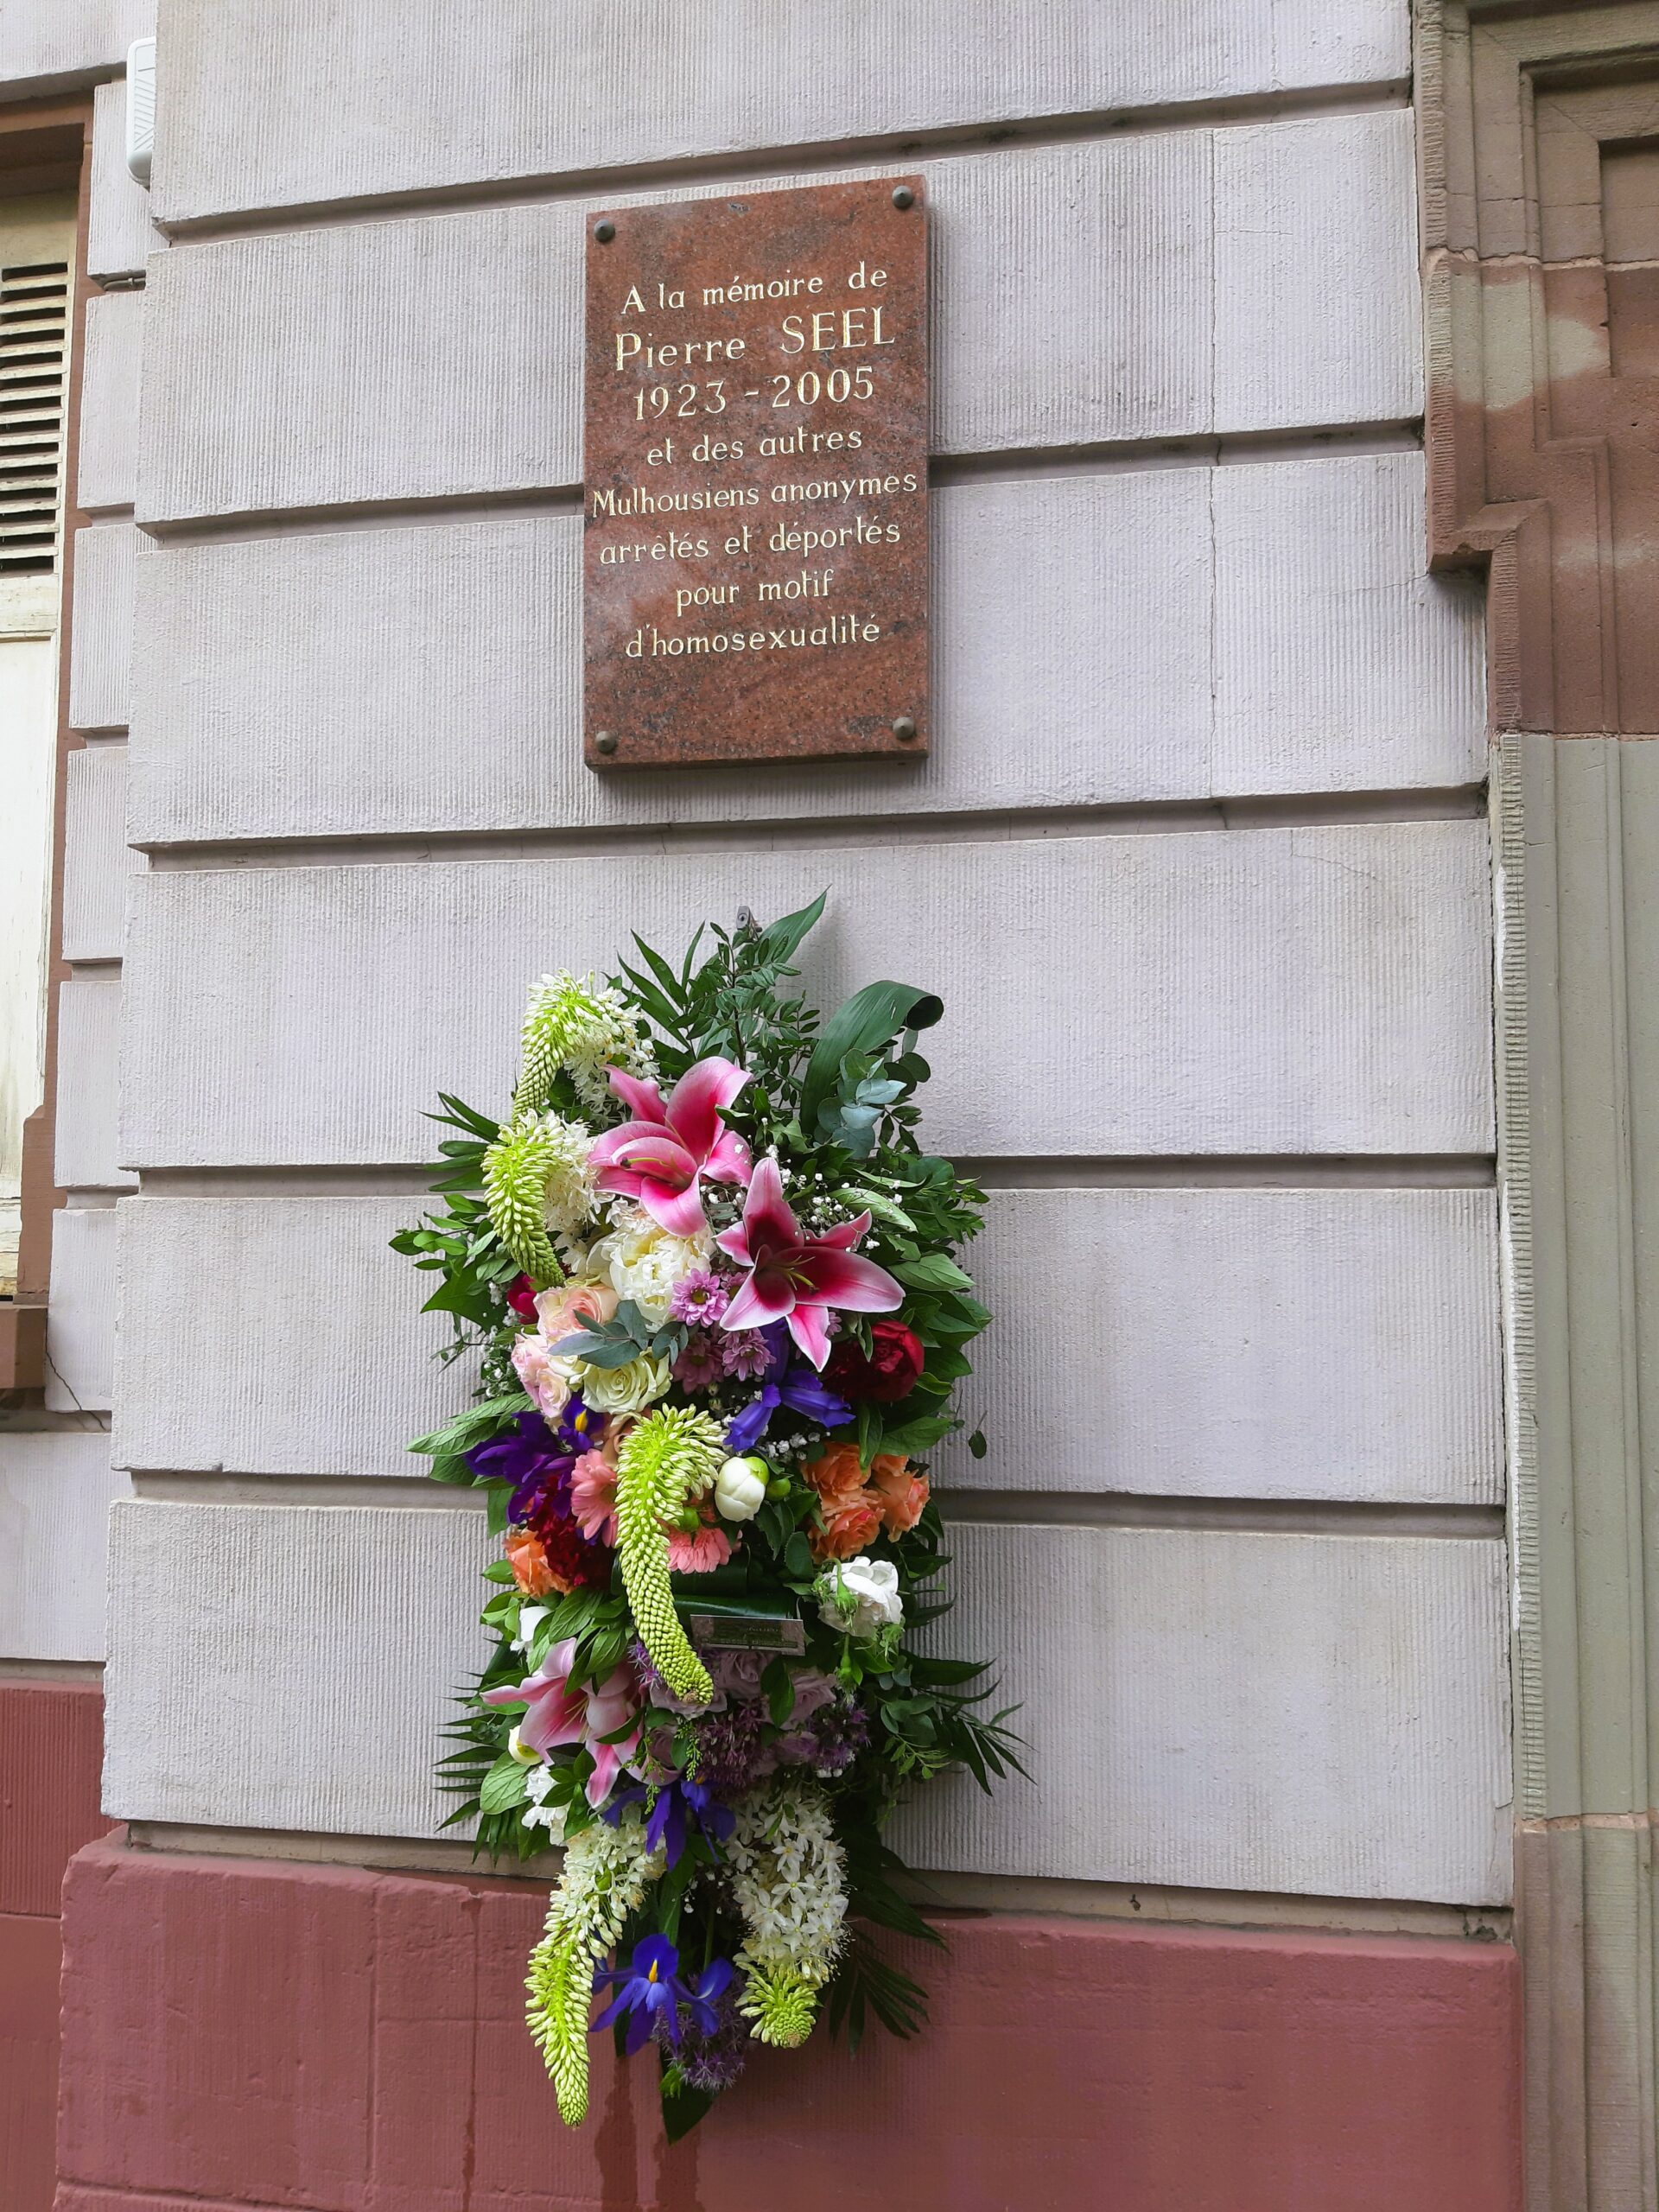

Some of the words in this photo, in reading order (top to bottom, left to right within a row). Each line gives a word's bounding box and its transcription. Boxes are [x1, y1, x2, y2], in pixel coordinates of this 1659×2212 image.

[620, 284, 646, 314] A
[658, 283, 685, 310] la
[702, 269, 823, 306] mémoire
[848, 260, 887, 289] de
[615, 332, 746, 371] Pierre
[779, 306, 895, 354] SEEL
[634, 380, 727, 421] 1923
[772, 365, 874, 409] 2005
[646, 437, 676, 466] et
[692, 435, 744, 462] des
[760, 426, 862, 457] autres
[593, 483, 760, 518] Mulhousiens
[771, 473, 918, 505] anonymes
[724, 525, 753, 555] et
[769, 515, 901, 557] déportés
[677, 583, 740, 617] pour
[758, 569, 835, 602] motif
[626, 613, 880, 658] d'homosexualité
